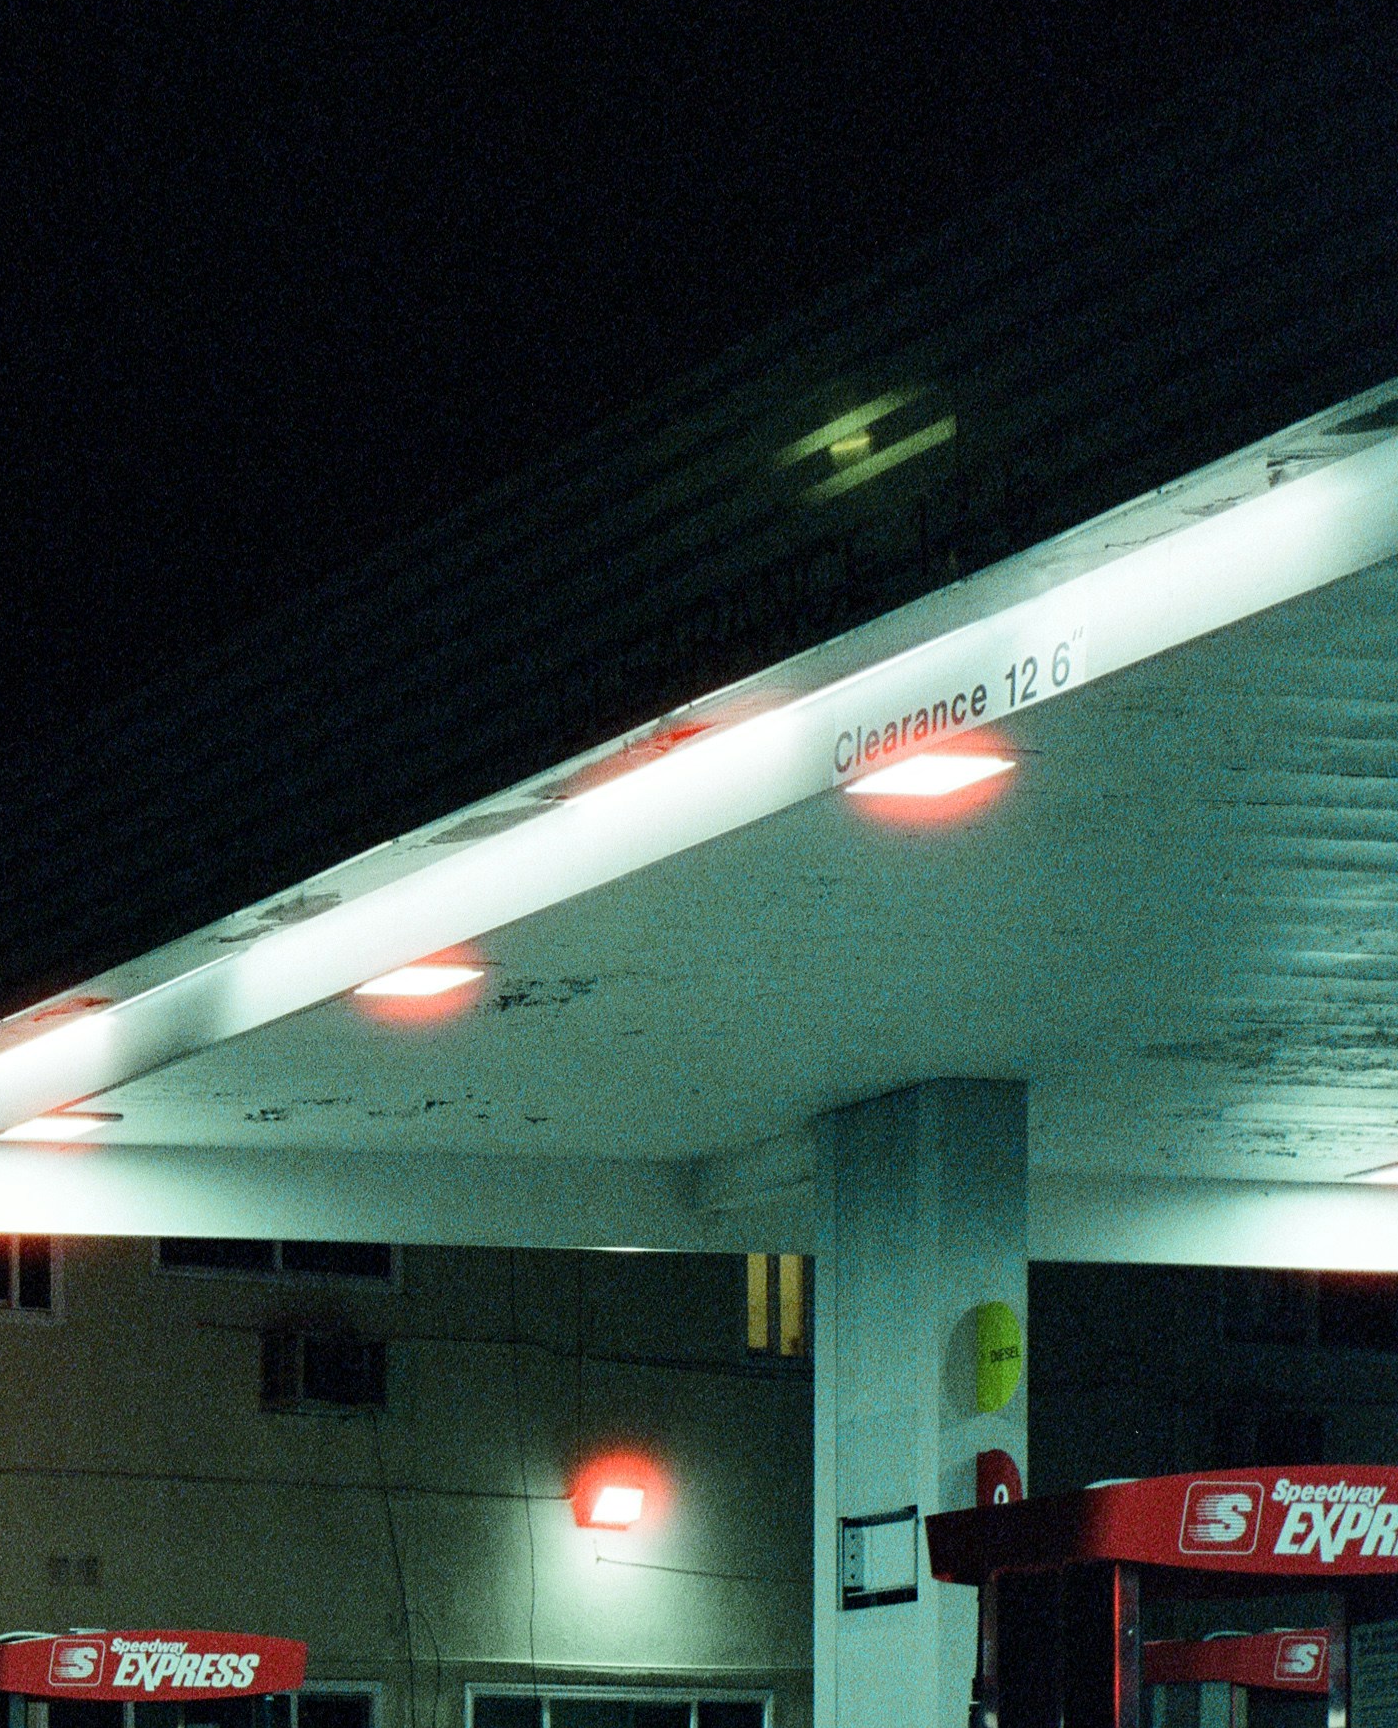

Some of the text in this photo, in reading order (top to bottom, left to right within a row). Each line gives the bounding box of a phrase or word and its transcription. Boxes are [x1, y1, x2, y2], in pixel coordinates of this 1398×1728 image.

[834, 684, 987, 774] Clearance
[1004, 655, 1038, 708] 12
[1272, 1479, 1387, 1507] Speedway
[1273, 1503, 1398, 1563] EXPR
[110, 1638, 188, 1656] Speedway
[112, 1653, 260, 1692] EXPRESS
